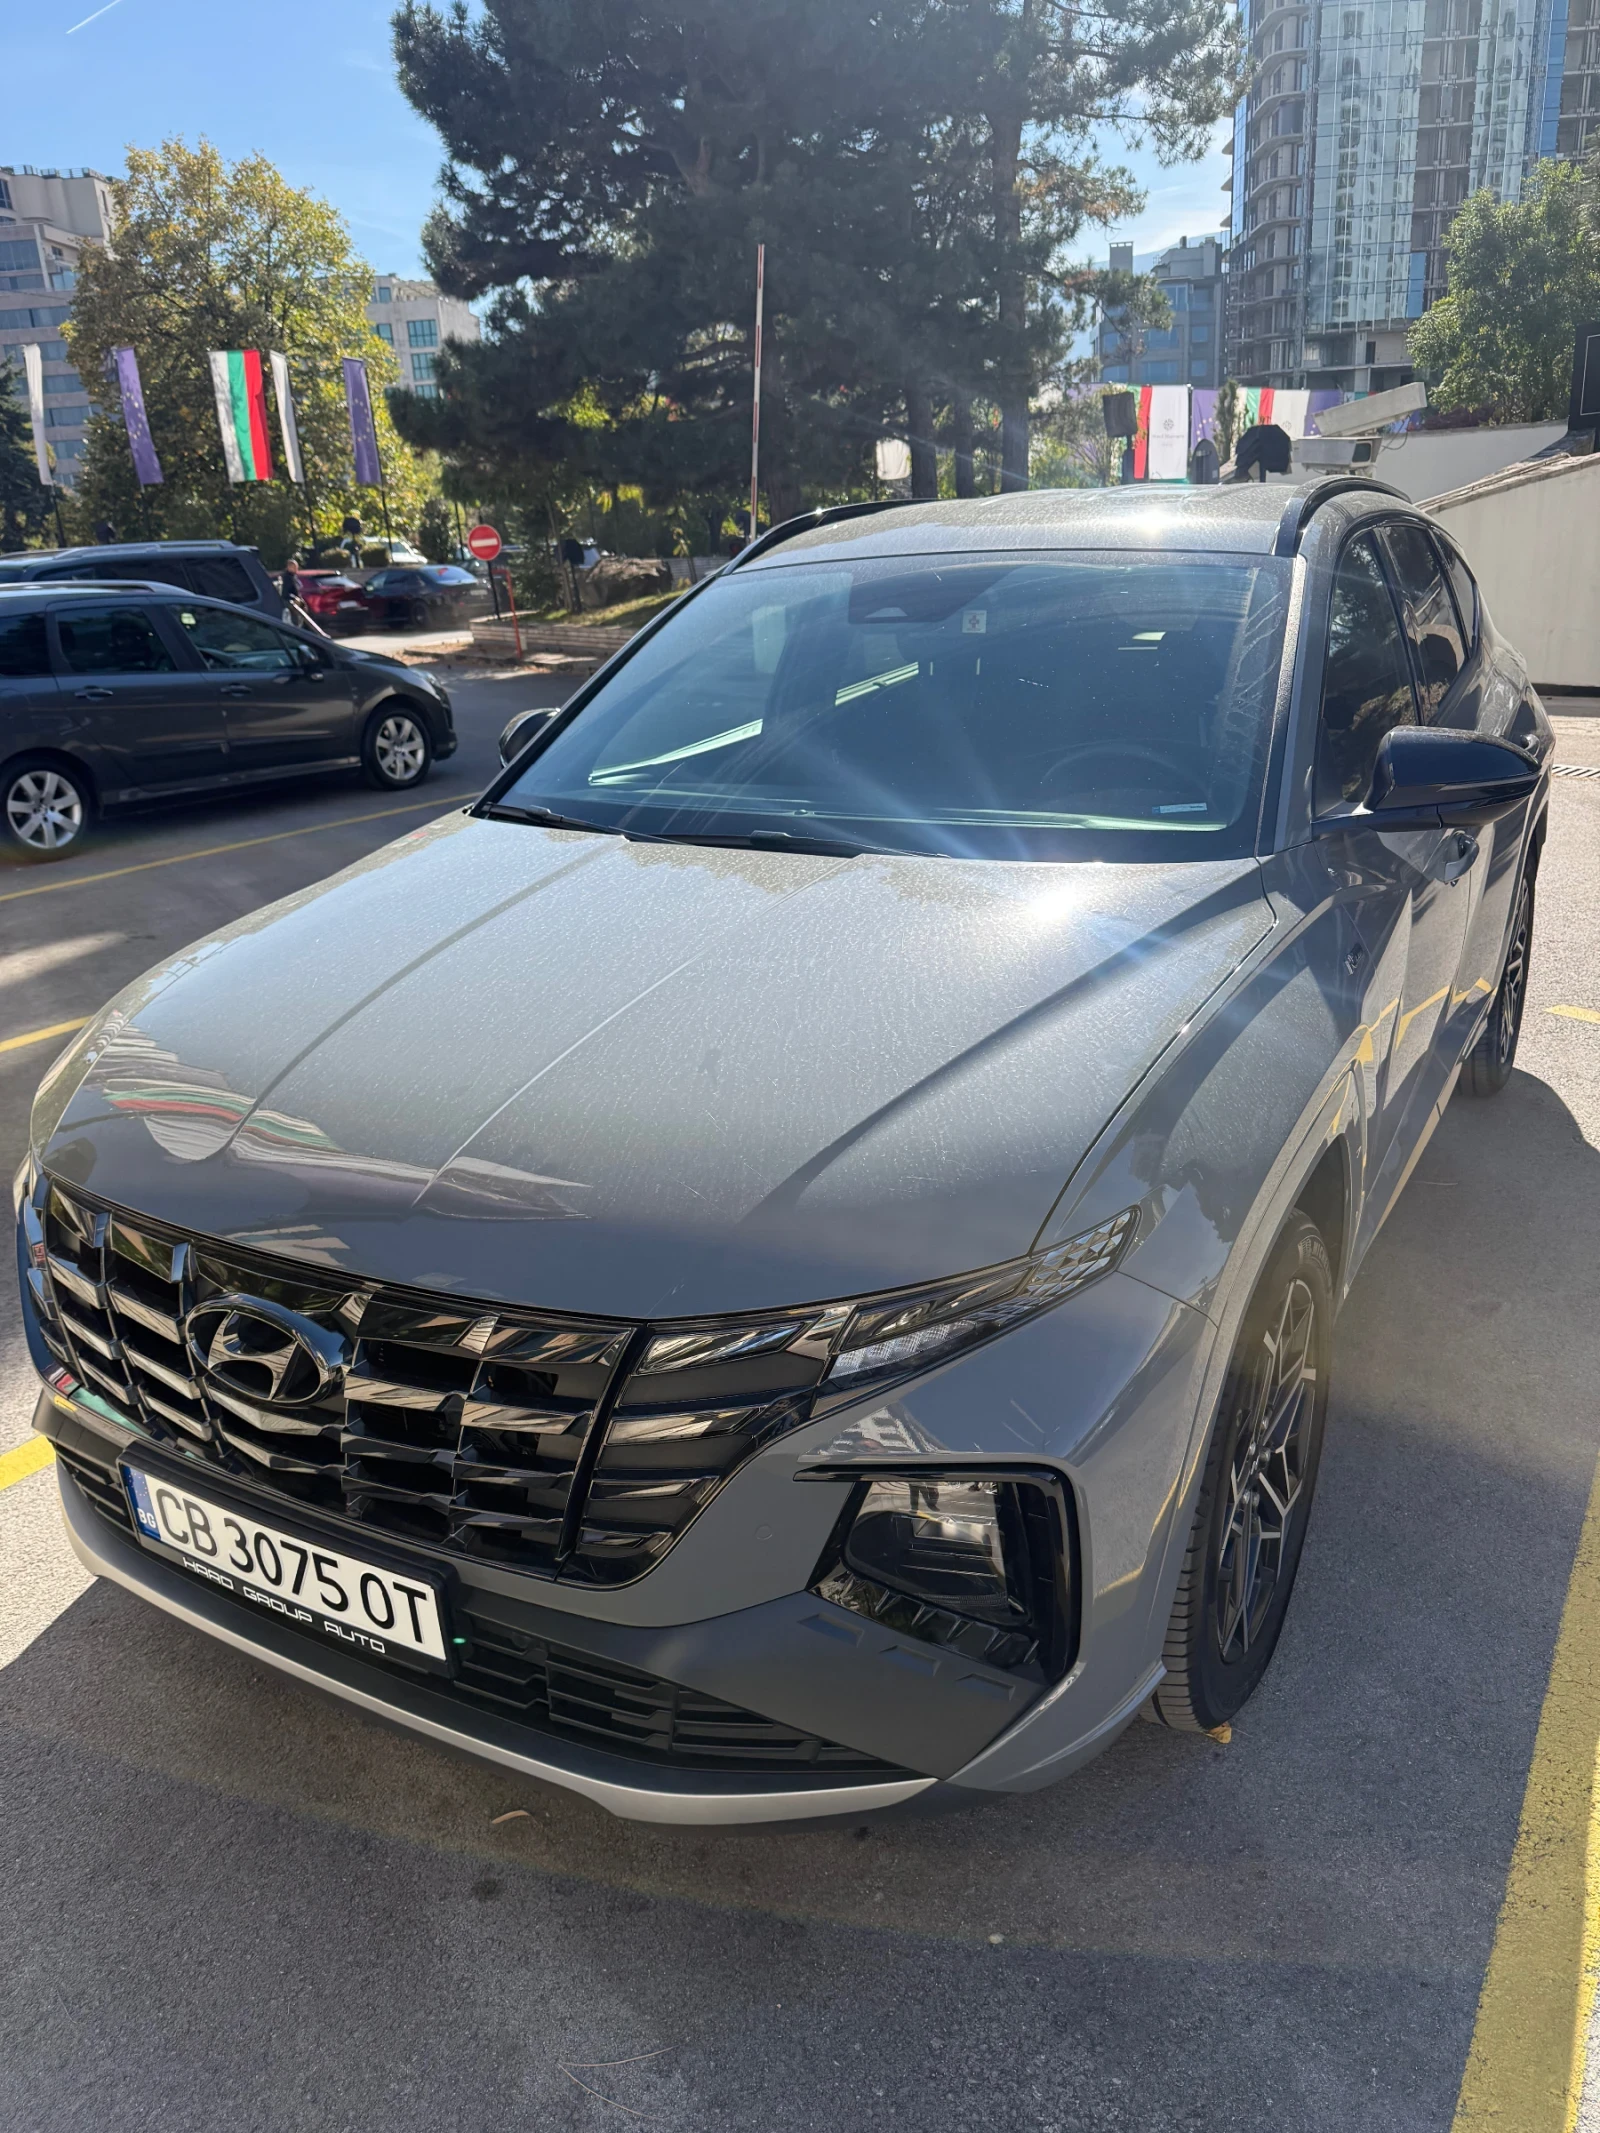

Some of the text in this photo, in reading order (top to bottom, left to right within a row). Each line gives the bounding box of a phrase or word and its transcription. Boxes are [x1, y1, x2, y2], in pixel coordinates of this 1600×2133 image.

[136, 1507, 157, 1529] BG
[155, 1488, 428, 1644] CB 3075 OT
[182, 1556, 386, 1654] HARD GROUP AUTO
